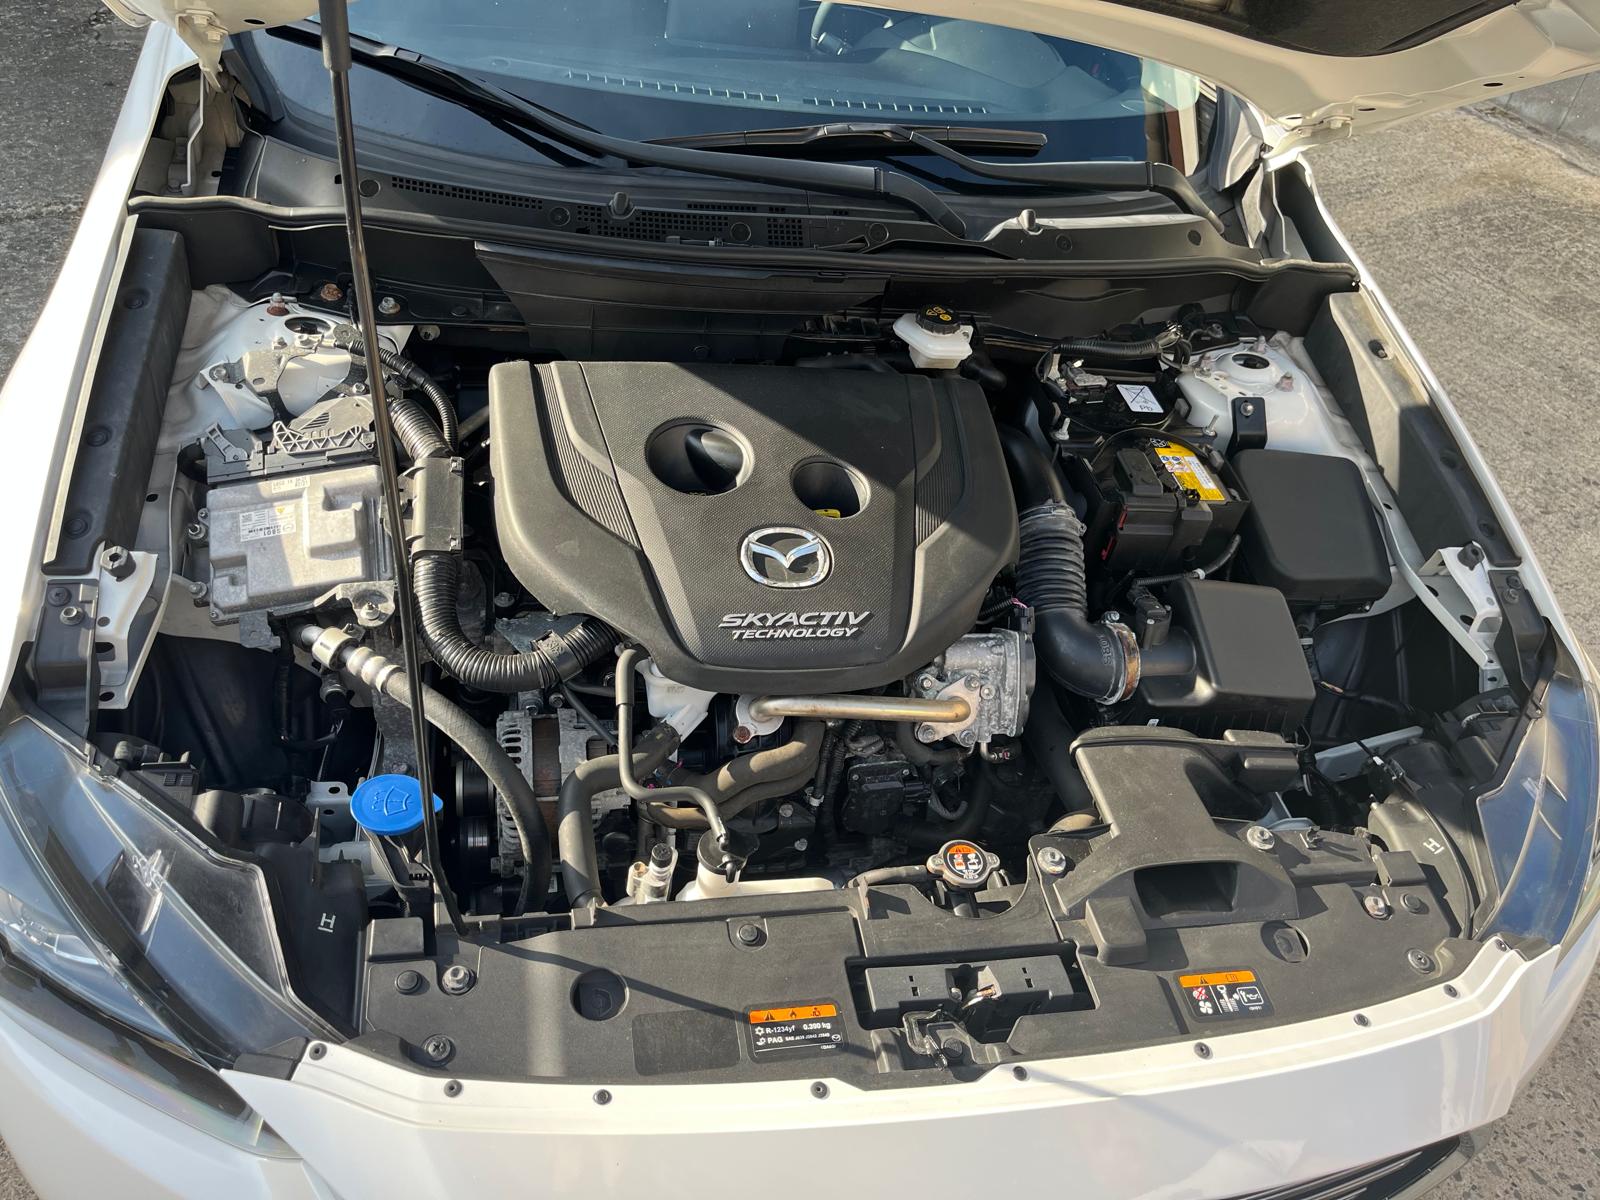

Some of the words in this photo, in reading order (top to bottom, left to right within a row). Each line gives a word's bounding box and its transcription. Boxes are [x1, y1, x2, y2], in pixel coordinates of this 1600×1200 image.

[718, 611, 870, 628] SKYACTIV
[732, 627, 859, 640] TECHNOLOGY
[319, 912, 336, 929] H
[765, 1024, 795, 1034] R-1234yf
[821, 1022, 831, 1030] kg
[767, 1036, 784, 1044] PAG
